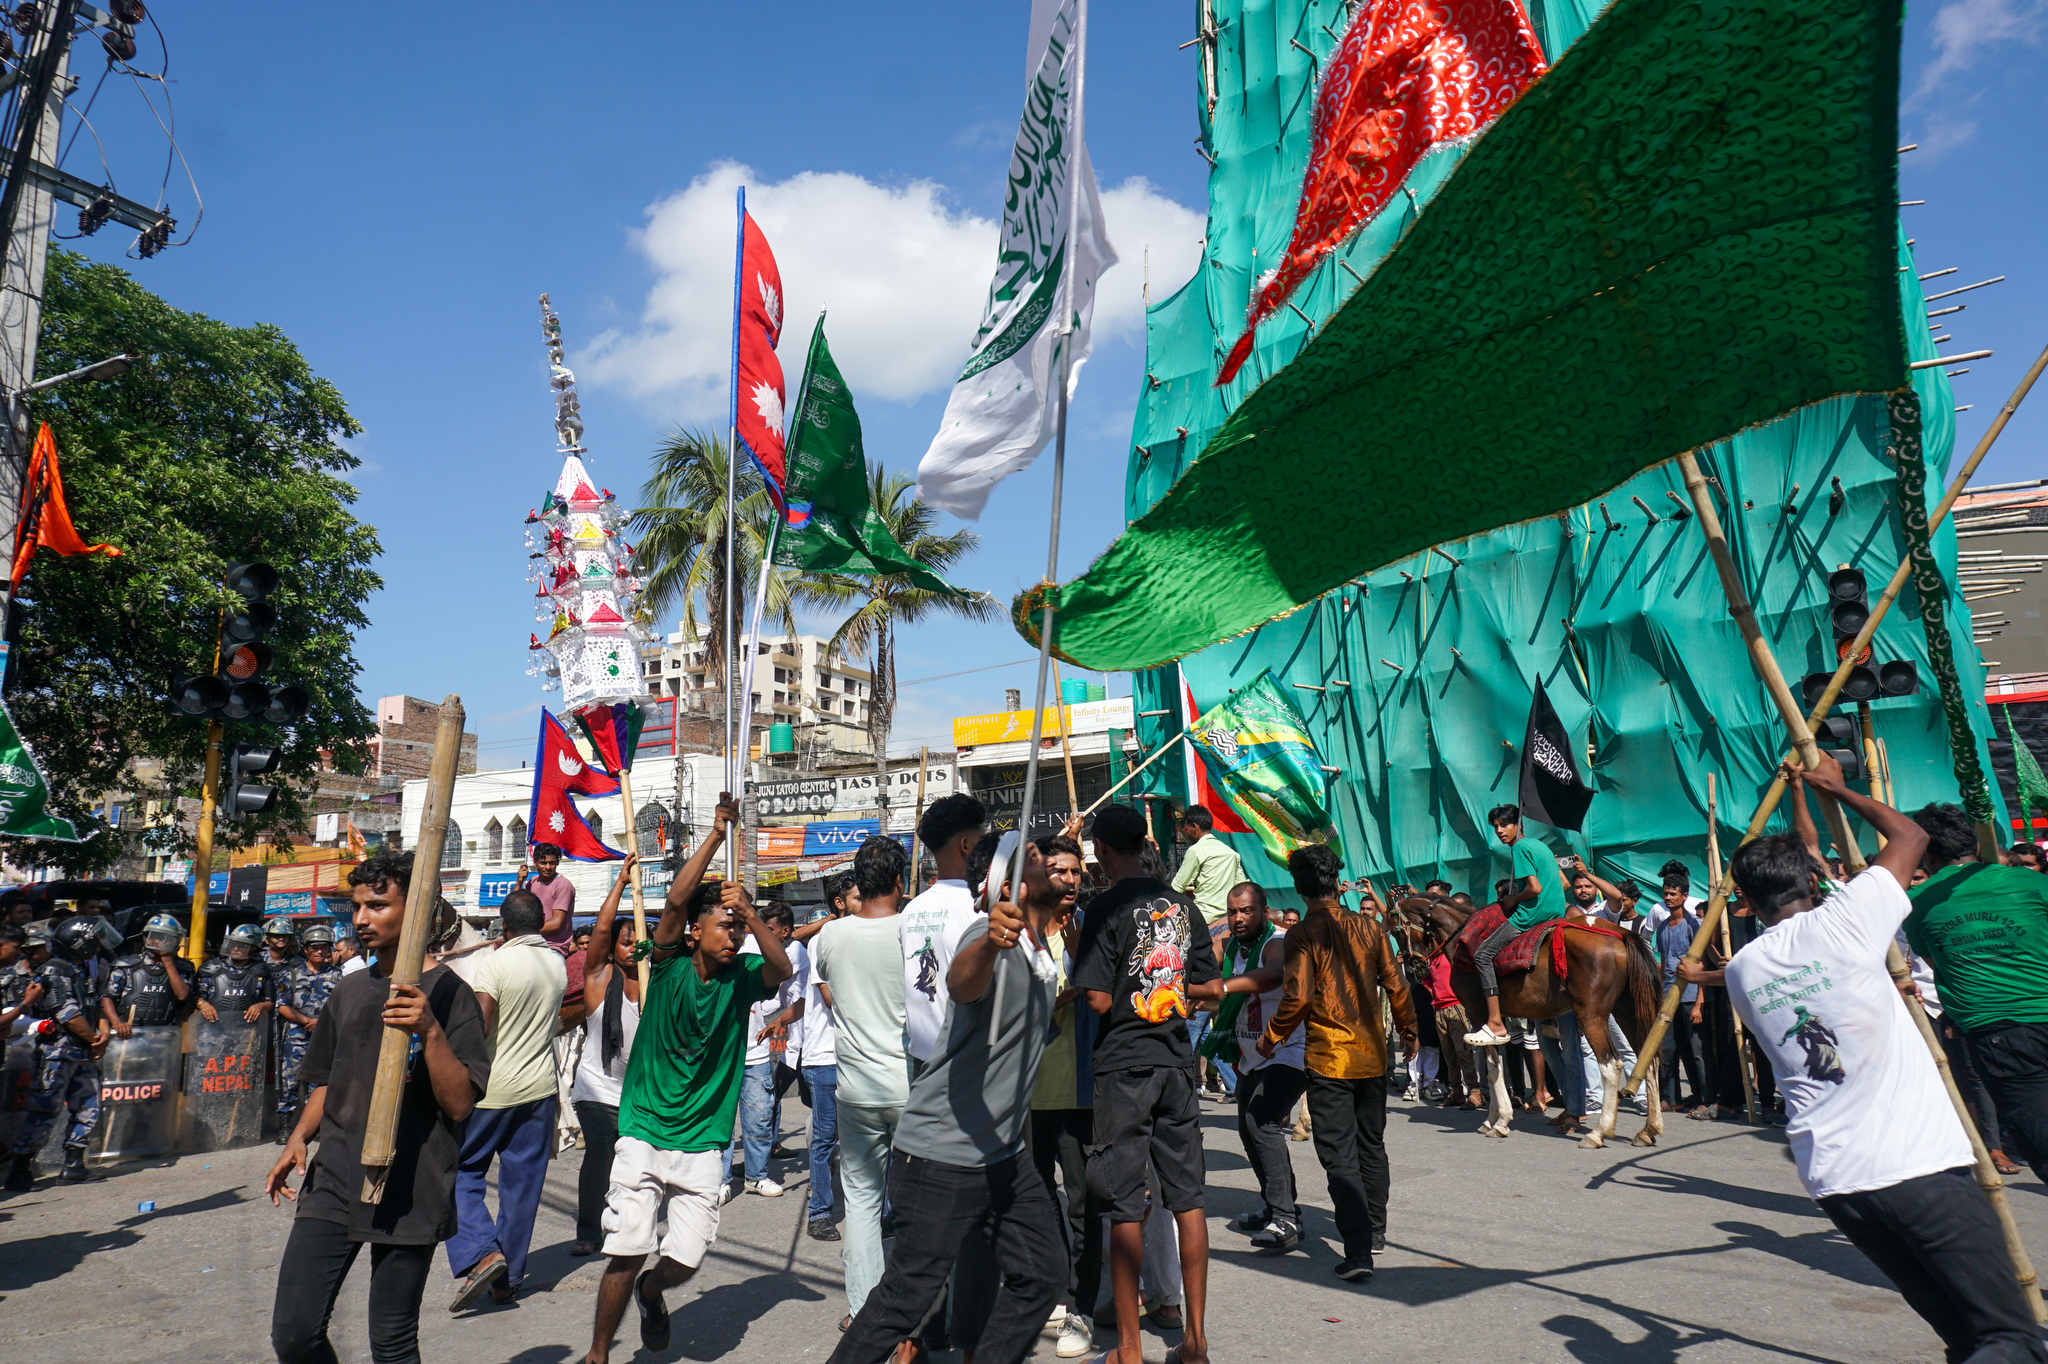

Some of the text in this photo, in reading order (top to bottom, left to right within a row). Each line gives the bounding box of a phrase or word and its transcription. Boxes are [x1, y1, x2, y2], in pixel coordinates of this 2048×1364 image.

[800, 780, 831, 793] CENTER
[816, 826, 869, 845] vivo
[485, 881, 517, 899] TEC
[143, 984, 166, 993] A.P.F.
[224, 989, 247, 997] A.P.F.
[1747, 986, 1763, 1001] हम
[201, 1074, 253, 1094] NEPAL
[101, 1085, 162, 1101] POLICE
